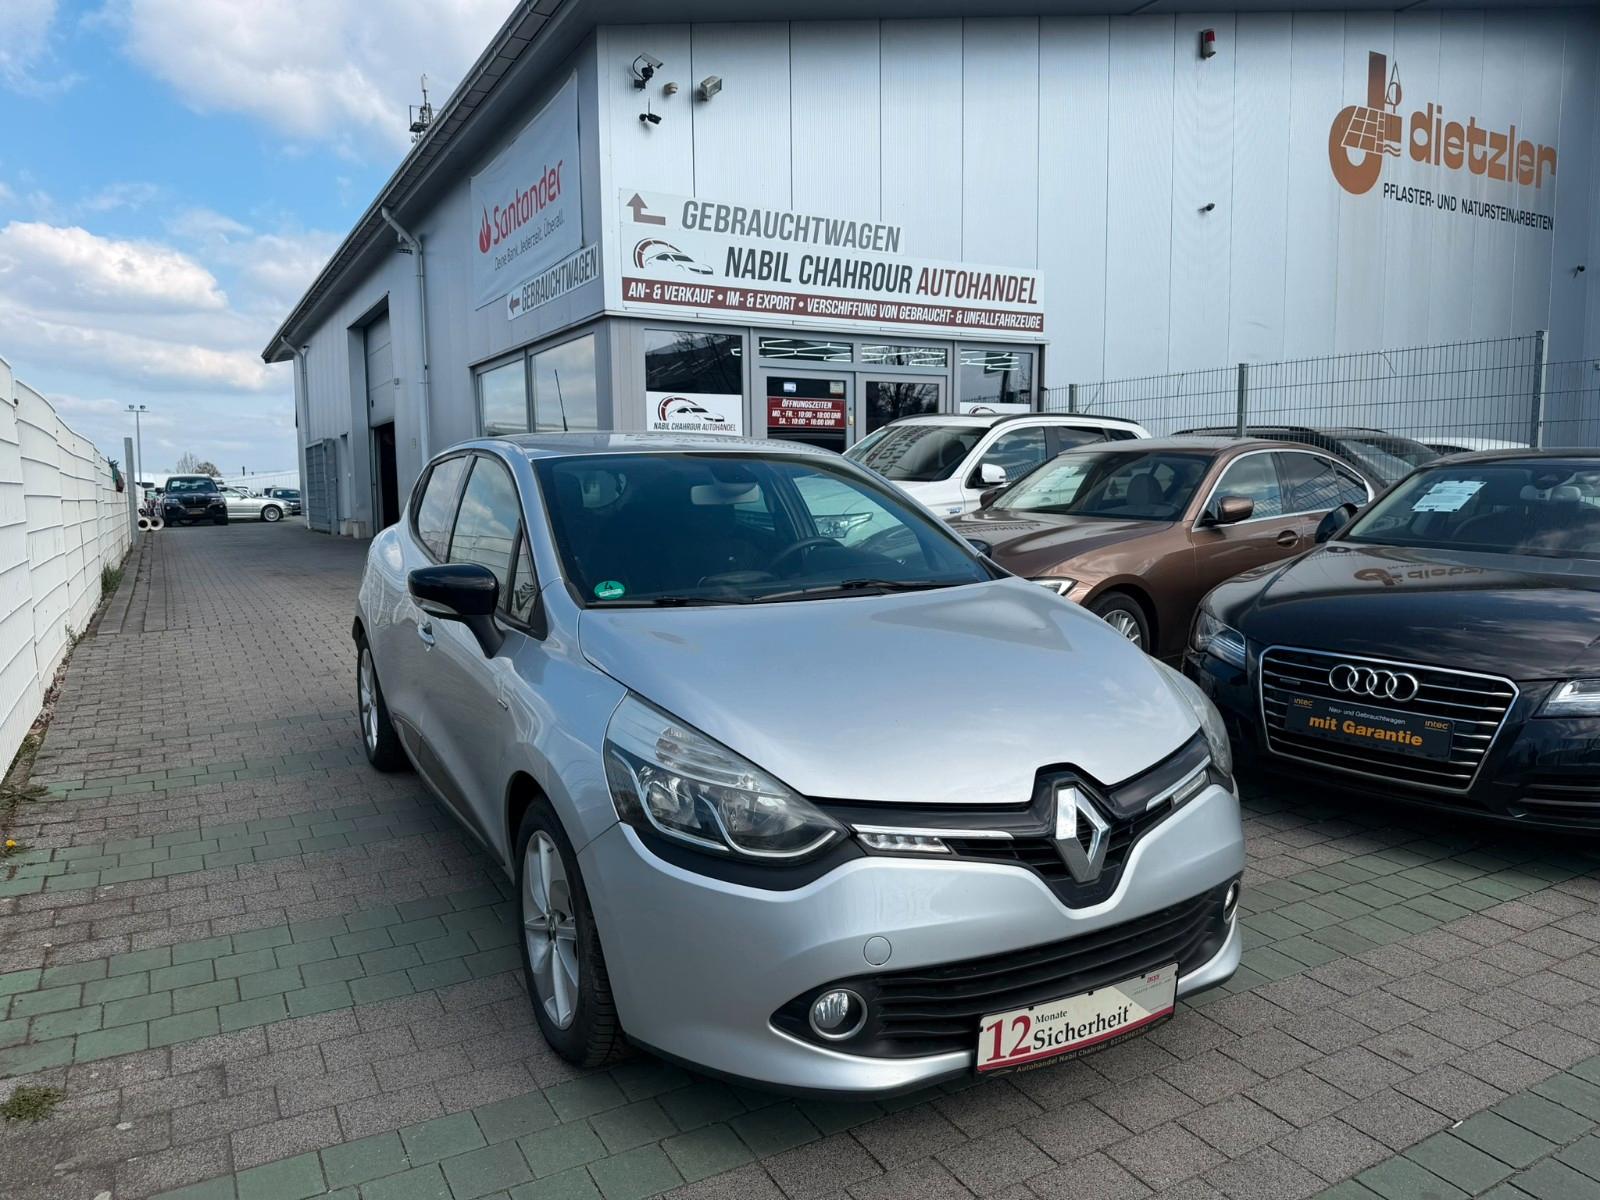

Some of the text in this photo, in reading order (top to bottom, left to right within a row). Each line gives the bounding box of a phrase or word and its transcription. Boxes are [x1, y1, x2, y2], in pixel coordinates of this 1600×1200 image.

[1409, 102, 1558, 189] dietzler
[493, 160, 563, 245] Santander
[1383, 182, 1554, 231] PFLASTER- UND NATURSTEINARBEITEN
[682, 200, 901, 253] GEBRAUCHTWAGEN
[522, 246, 597, 311] GEBRAUCHTWAGEN
[725, 246, 1038, 304] NABIL CHAHROUR AUTOHANDEL
[628, 282, 1042, 329] AN- & VERKAUF IM- & EXPORT VERSCHIFFUNG VON GEBRAUCHT- & UNFALLFAHRZEUGE
[654, 422, 736, 432] NABIL CHAHROUR AUTOHANDEL
[781, 399, 832, 409] ÖFFNUNGSZEITEN
[1309, 716, 1423, 747] mit Garantie
[1328, 706, 1406, 725] Neu- und Gebrauchtwagen
[1424, 720, 1448, 730] intec
[986, 1014, 1033, 1062] 12
[1034, 1009, 1068, 1025] Monate
